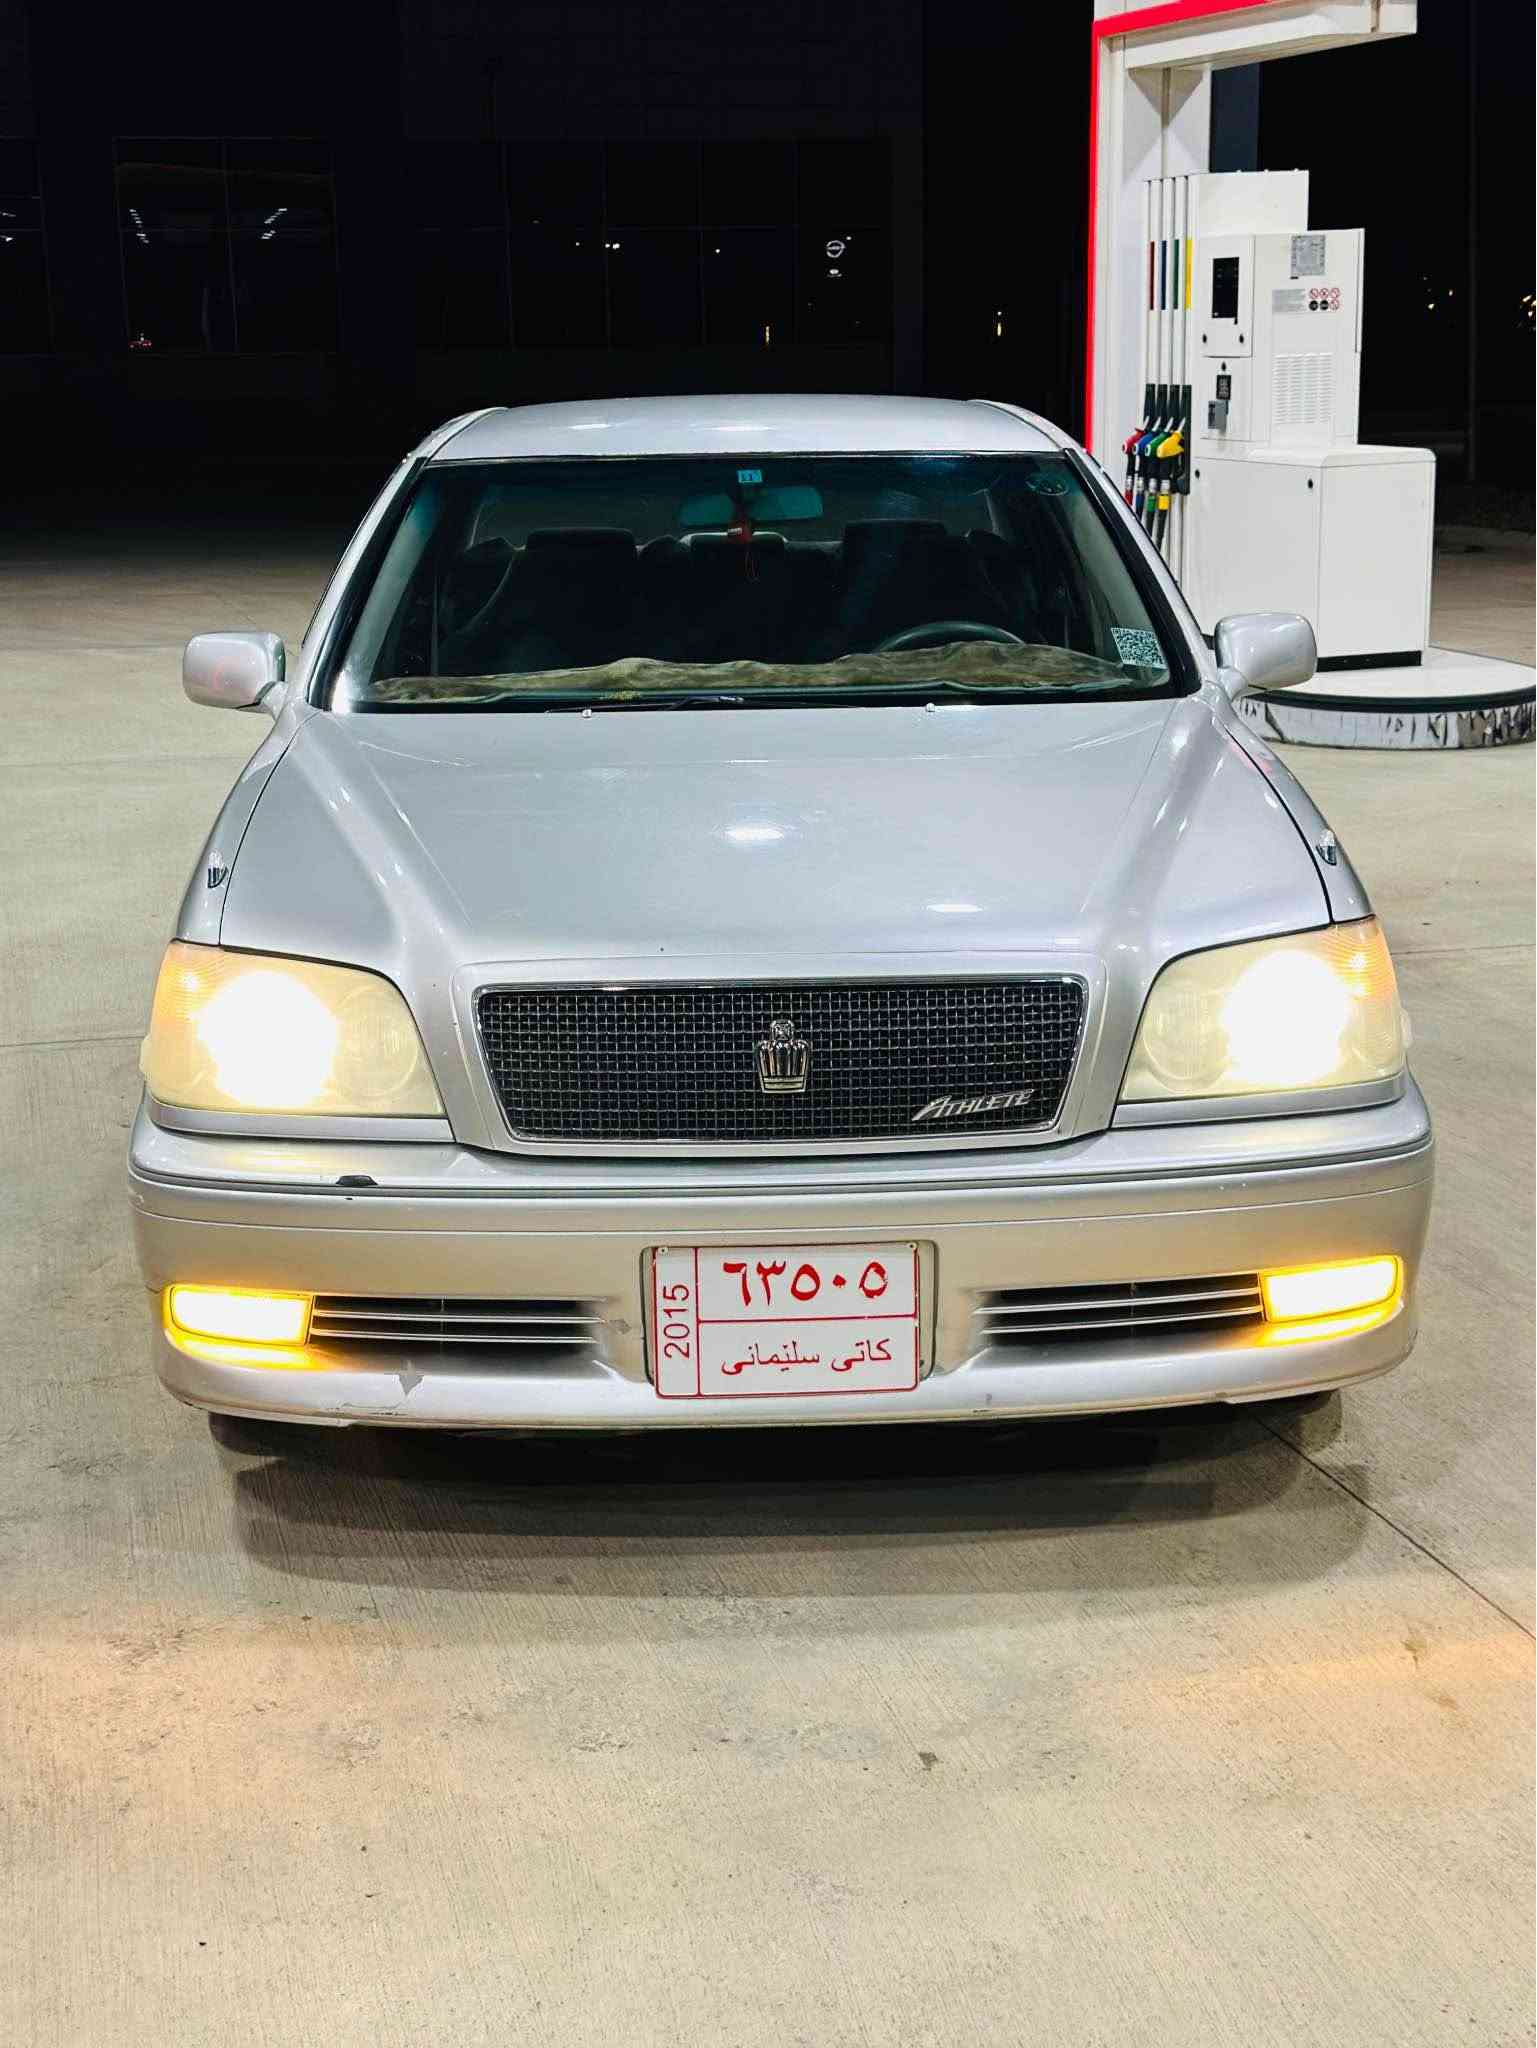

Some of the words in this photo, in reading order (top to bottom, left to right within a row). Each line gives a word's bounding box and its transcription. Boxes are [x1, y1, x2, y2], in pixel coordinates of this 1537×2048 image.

[911, 1089, 1035, 1121] ATHLETE
[722, 1260, 889, 1307] ٦٣٥٠٥
[663, 1284, 690, 1360] 2015
